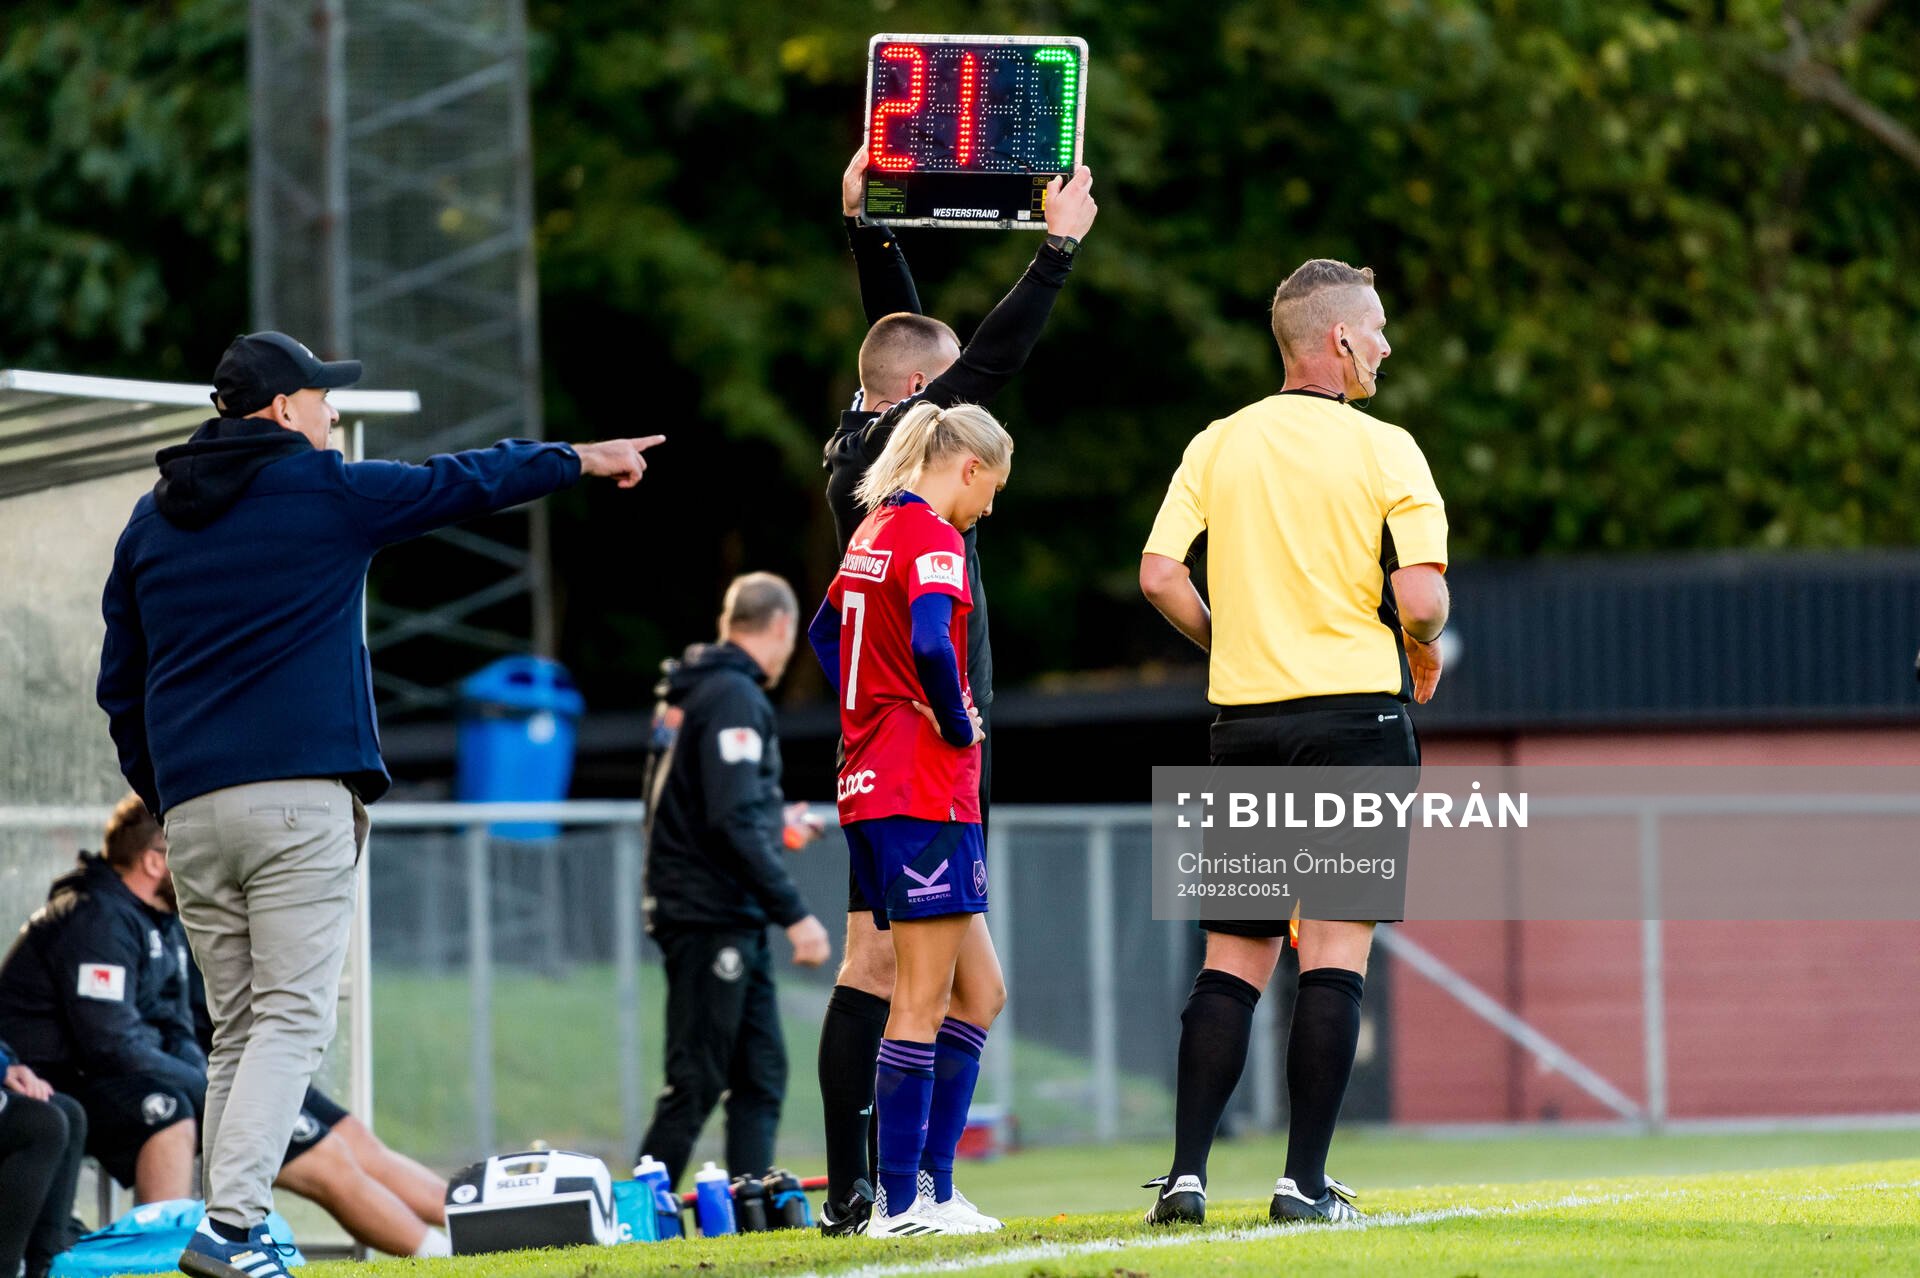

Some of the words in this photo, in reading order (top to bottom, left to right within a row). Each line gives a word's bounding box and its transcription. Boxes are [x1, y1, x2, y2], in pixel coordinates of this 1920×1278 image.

[872, 46, 974, 168] 21
[1033, 47, 1076, 167] 7
[933, 207, 999, 219] WESTERSTRAND
[842, 590, 865, 710] 7
[496, 1177, 540, 1189] SELECT
